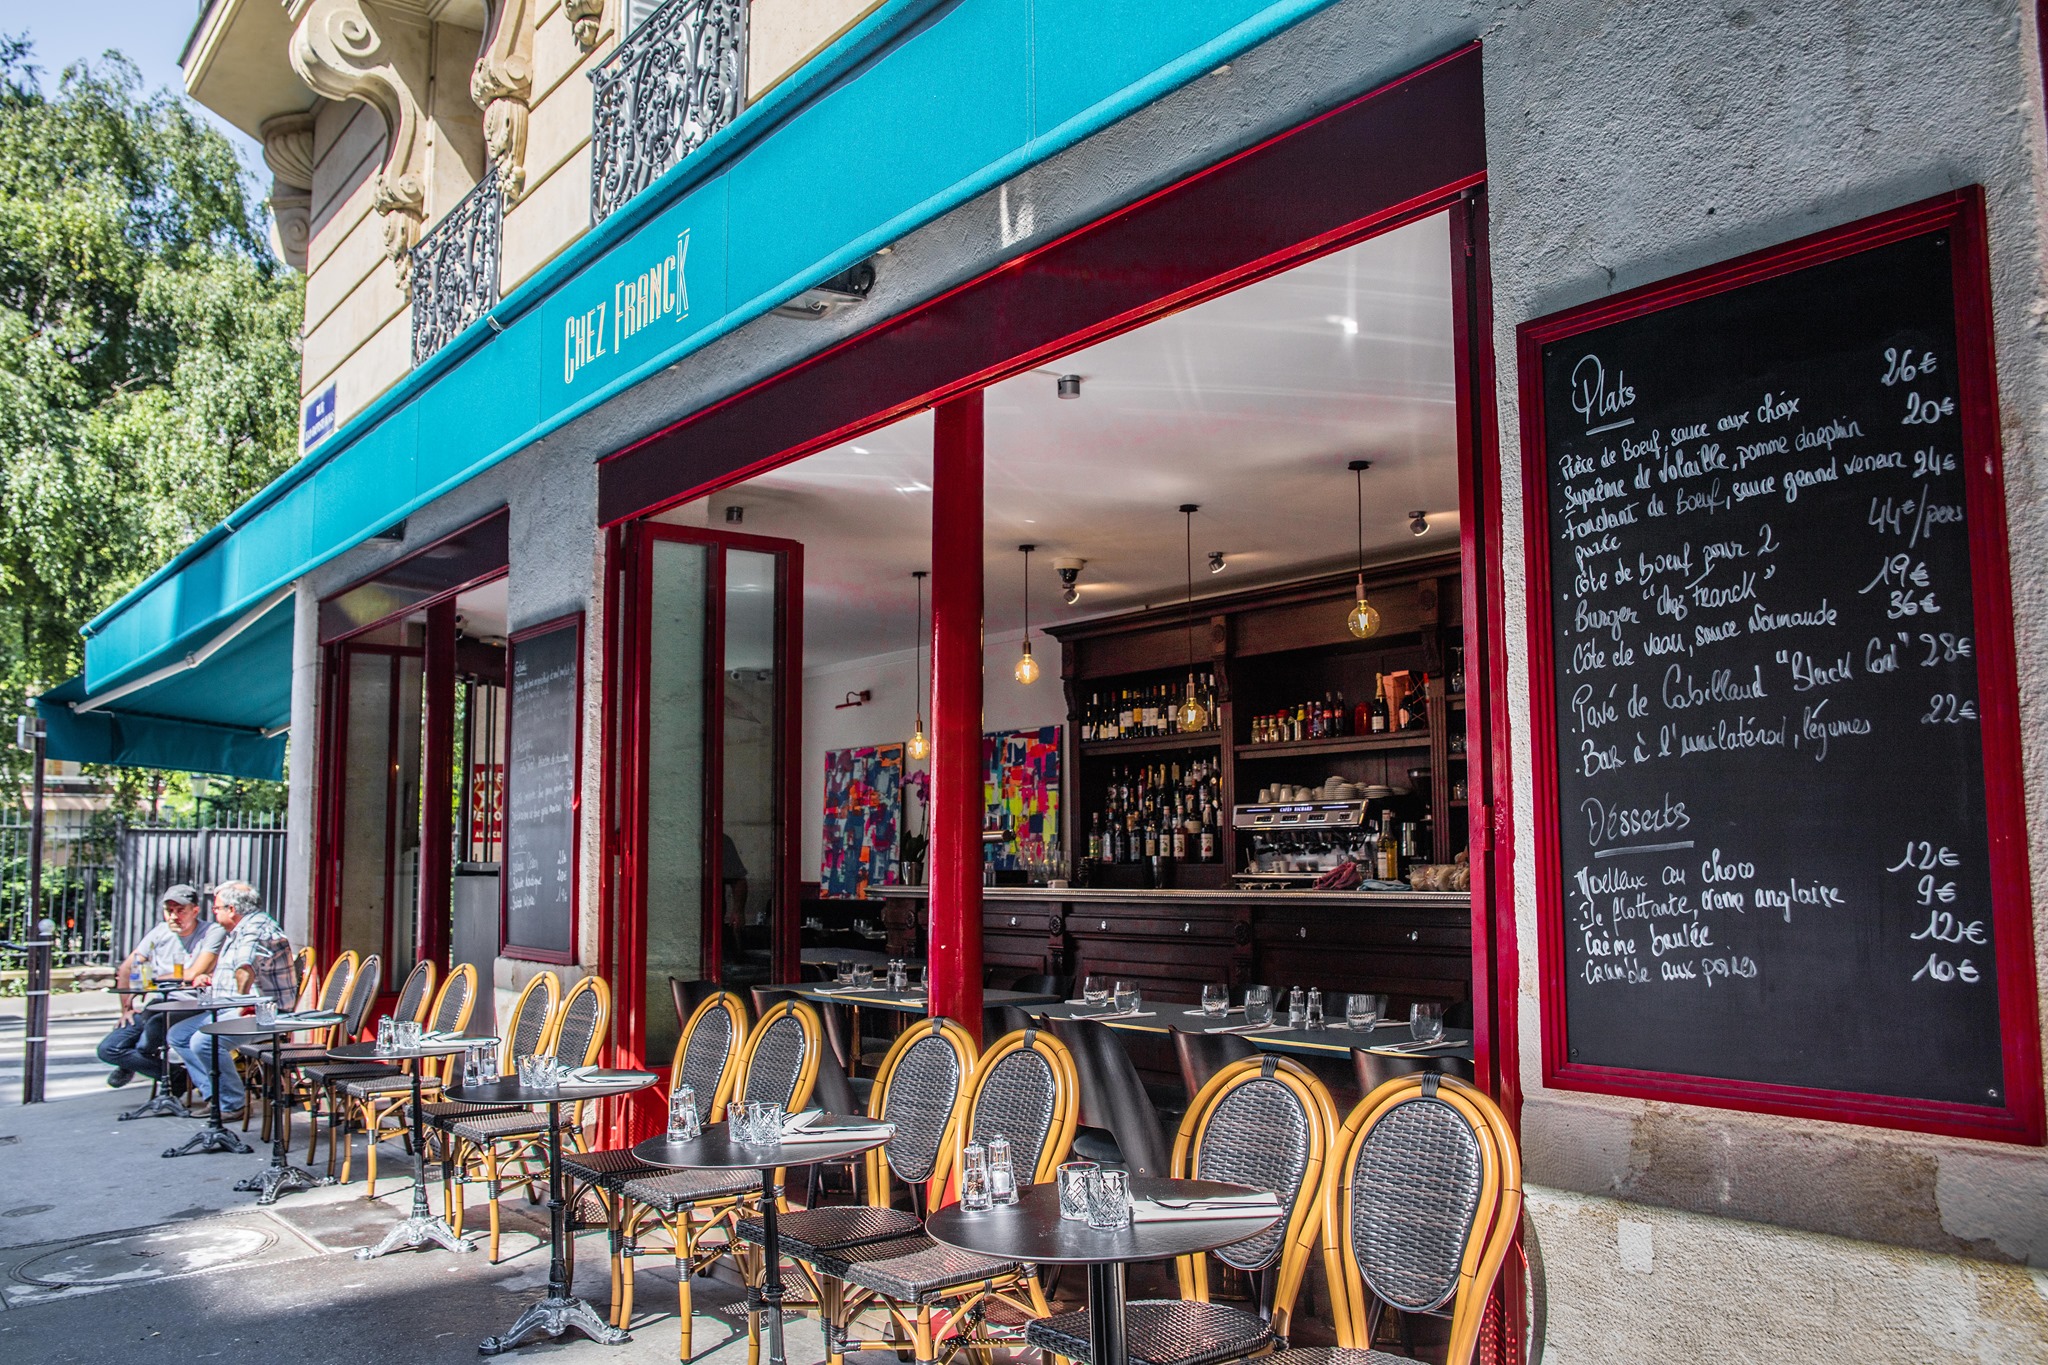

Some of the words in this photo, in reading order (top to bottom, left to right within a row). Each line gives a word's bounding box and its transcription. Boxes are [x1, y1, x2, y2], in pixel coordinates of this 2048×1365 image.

[565, 302, 606, 384] CHEZ
[614, 228, 691, 355] FRANCK
[1881, 347, 1937, 387] 26€
[1571, 354, 1636, 425] Plats
[1901, 391, 1955, 425] 20€
[1558, 454, 1596, 480] Pièce
[1601, 446, 1617, 469] de
[1671, 423, 1711, 447] sauce
[1717, 411, 1750, 431] aux
[1634, 463, 1651, 489] de
[1647, 492, 1668, 517] de
[1733, 476, 1776, 500] sauce
[1614, 557, 1634, 585] de
[1702, 540, 1749, 576] pour
[1757, 523, 1780, 557] 2
[1858, 552, 1930, 594] 19€
[1575, 599, 1640, 641] Burger
[1887, 589, 1941, 620] 36€
[1612, 640, 1635, 667] de
[1627, 683, 1649, 719] de
[1919, 632, 1972, 667] 28€
[1920, 693, 1978, 725] 22€
[1633, 731, 1650, 764] à
[1803, 698, 1871, 762] légumes
[1702, 847, 1756, 884] choco
[1886, 841, 1960, 872] 12€
[1754, 877, 1846, 924] anglaise
[1917, 874, 1957, 906] 9€
[1910, 909, 1988, 945] 12€
[1660, 960, 1697, 981] aux
[1911, 952, 1981, 983] 10€
